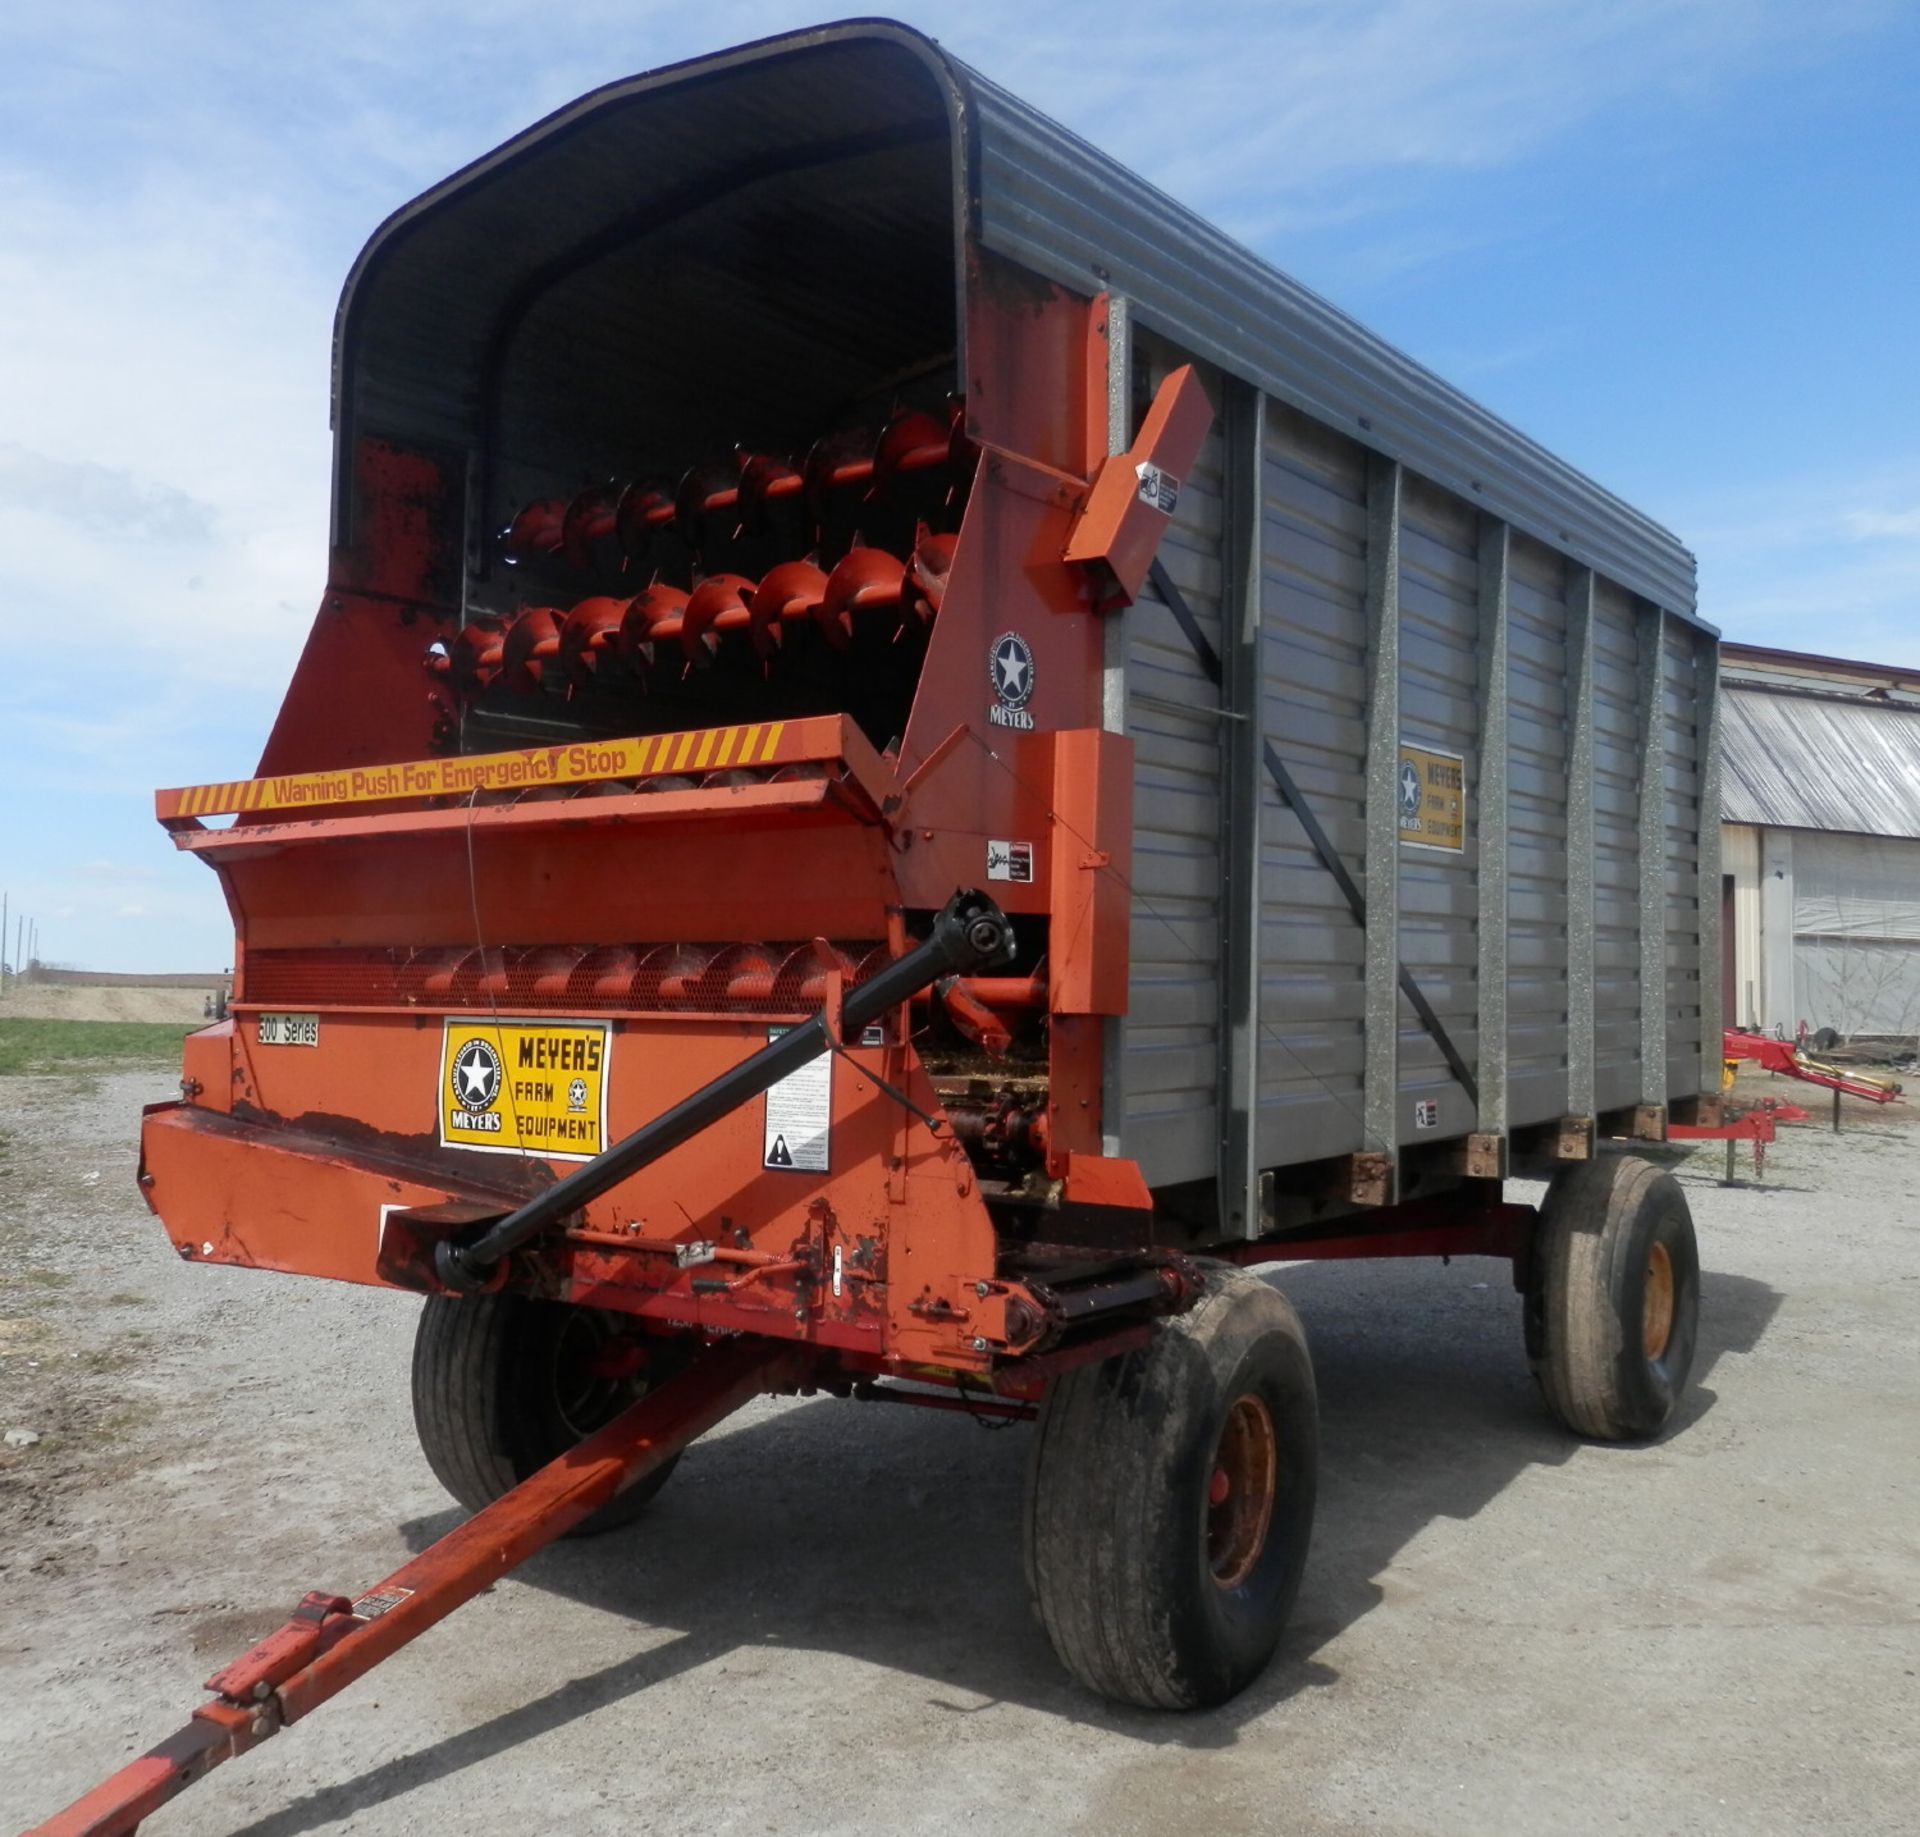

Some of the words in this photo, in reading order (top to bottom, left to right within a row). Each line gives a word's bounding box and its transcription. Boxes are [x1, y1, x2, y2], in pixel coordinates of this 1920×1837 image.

[273, 775, 348, 804] Warning
[351, 767, 399, 796] Push
[403, 764, 437, 790] For
[441, 752, 559, 789] Emergency
[568, 747, 627, 777] Stop
[284, 1016, 317, 1042] Series
[518, 1035, 601, 1072] MEYER'S
[515, 1081, 554, 1103] FARM
[452, 1111, 501, 1131] MEYER'S
[516, 1115, 596, 1141] EQUIPMENT
